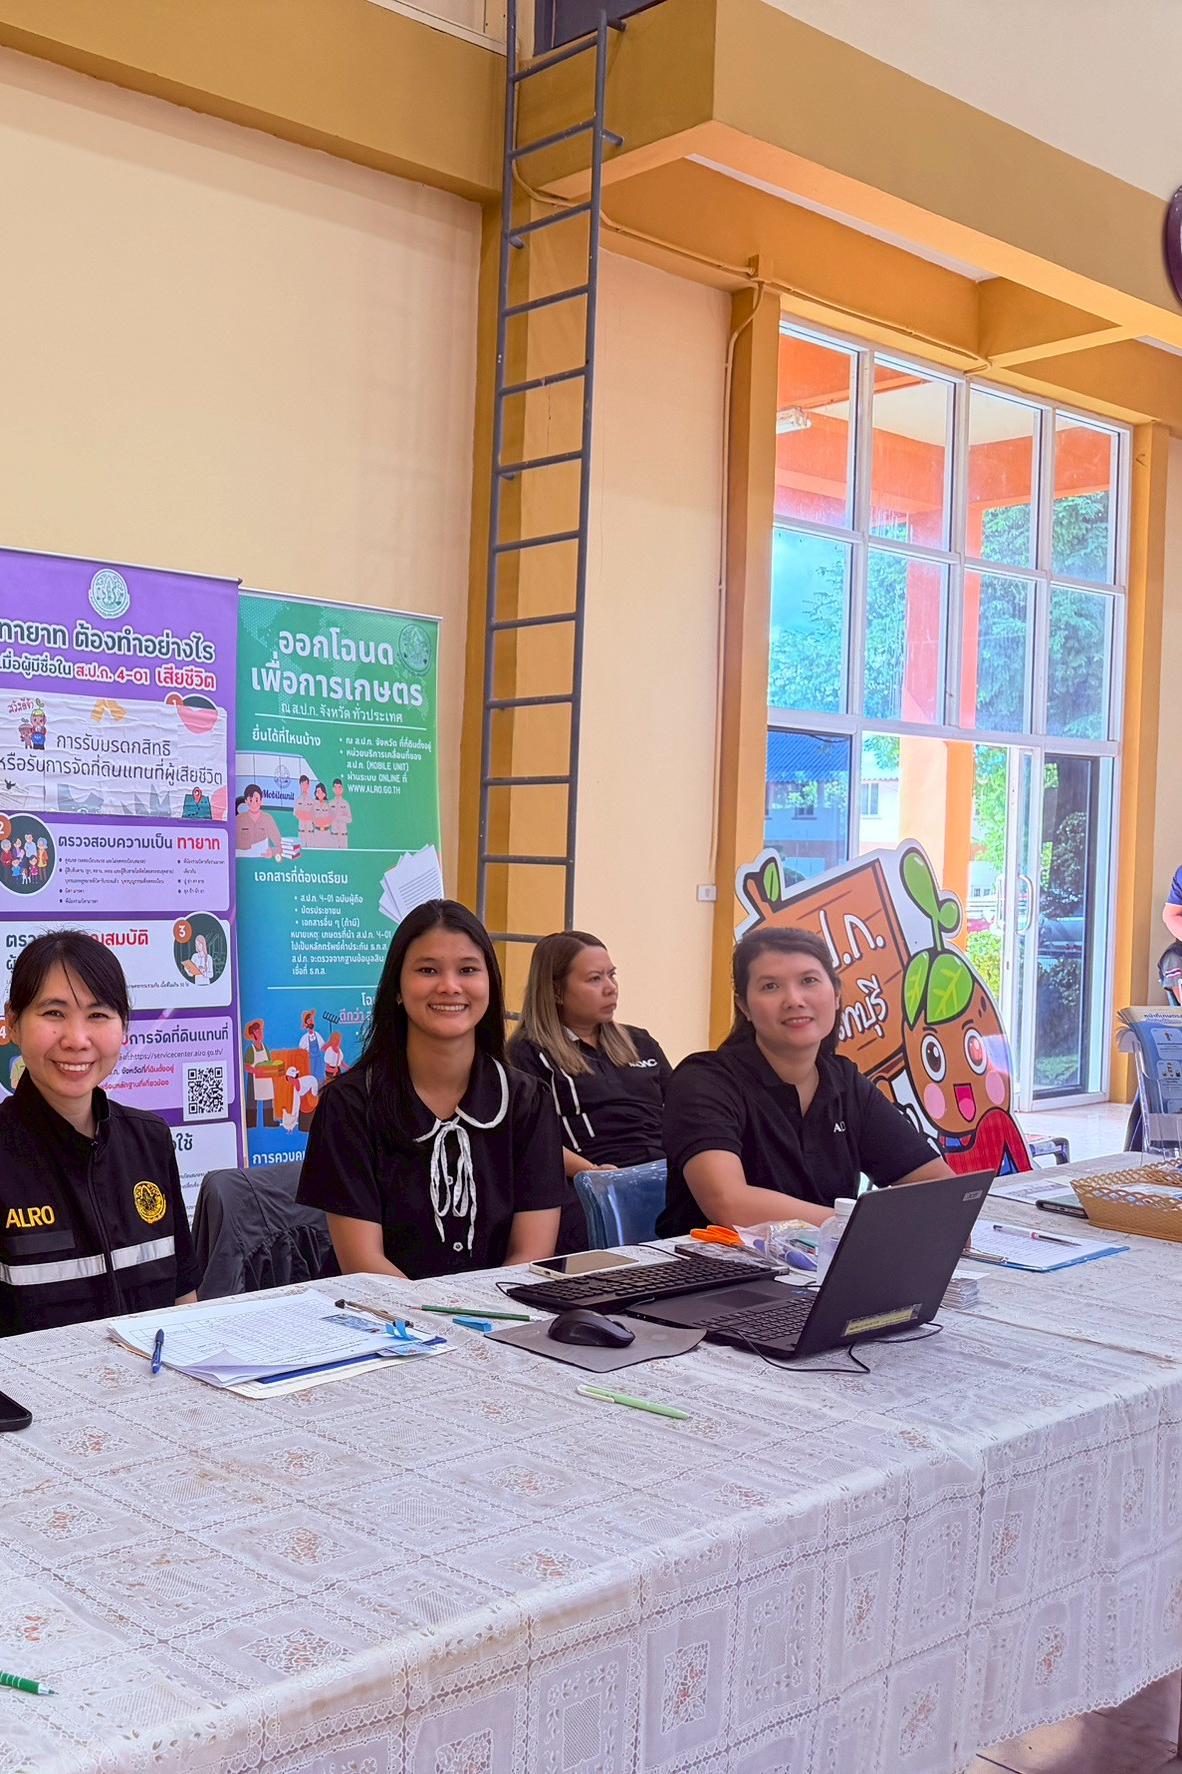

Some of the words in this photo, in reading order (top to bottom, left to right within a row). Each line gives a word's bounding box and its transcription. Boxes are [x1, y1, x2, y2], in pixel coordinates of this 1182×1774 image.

[75, 621, 214, 661] ต้องทำอย่างไร
[279, 628, 394, 665] ออกโฉนด
[76, 664, 112, 681] ส.ป.ก.
[116, 670, 149, 684] 4-01
[157, 666, 215, 689] เสียชีวิต
[252, 653, 423, 706] เพื่อการเกษตร
[320, 705, 351, 719] จังหวัด
[353, 707, 403, 723] ทั่วประเทศ
[56, 733, 171, 757] การรับมรดกสิทธิ
[252, 725, 321, 746] ยื่นได้ที่ไหนบ้าง
[58, 833, 173, 850] ตรวจสอบความเป็น
[177, 835, 220, 850] ทายาท
[254, 866, 348, 884] เอกสารที่ต้องเตรียม
[178, 925, 186, 937] 3
[361, 992, 375, 1006] โฉ
[6, 1205, 55, 1229] ALRO
